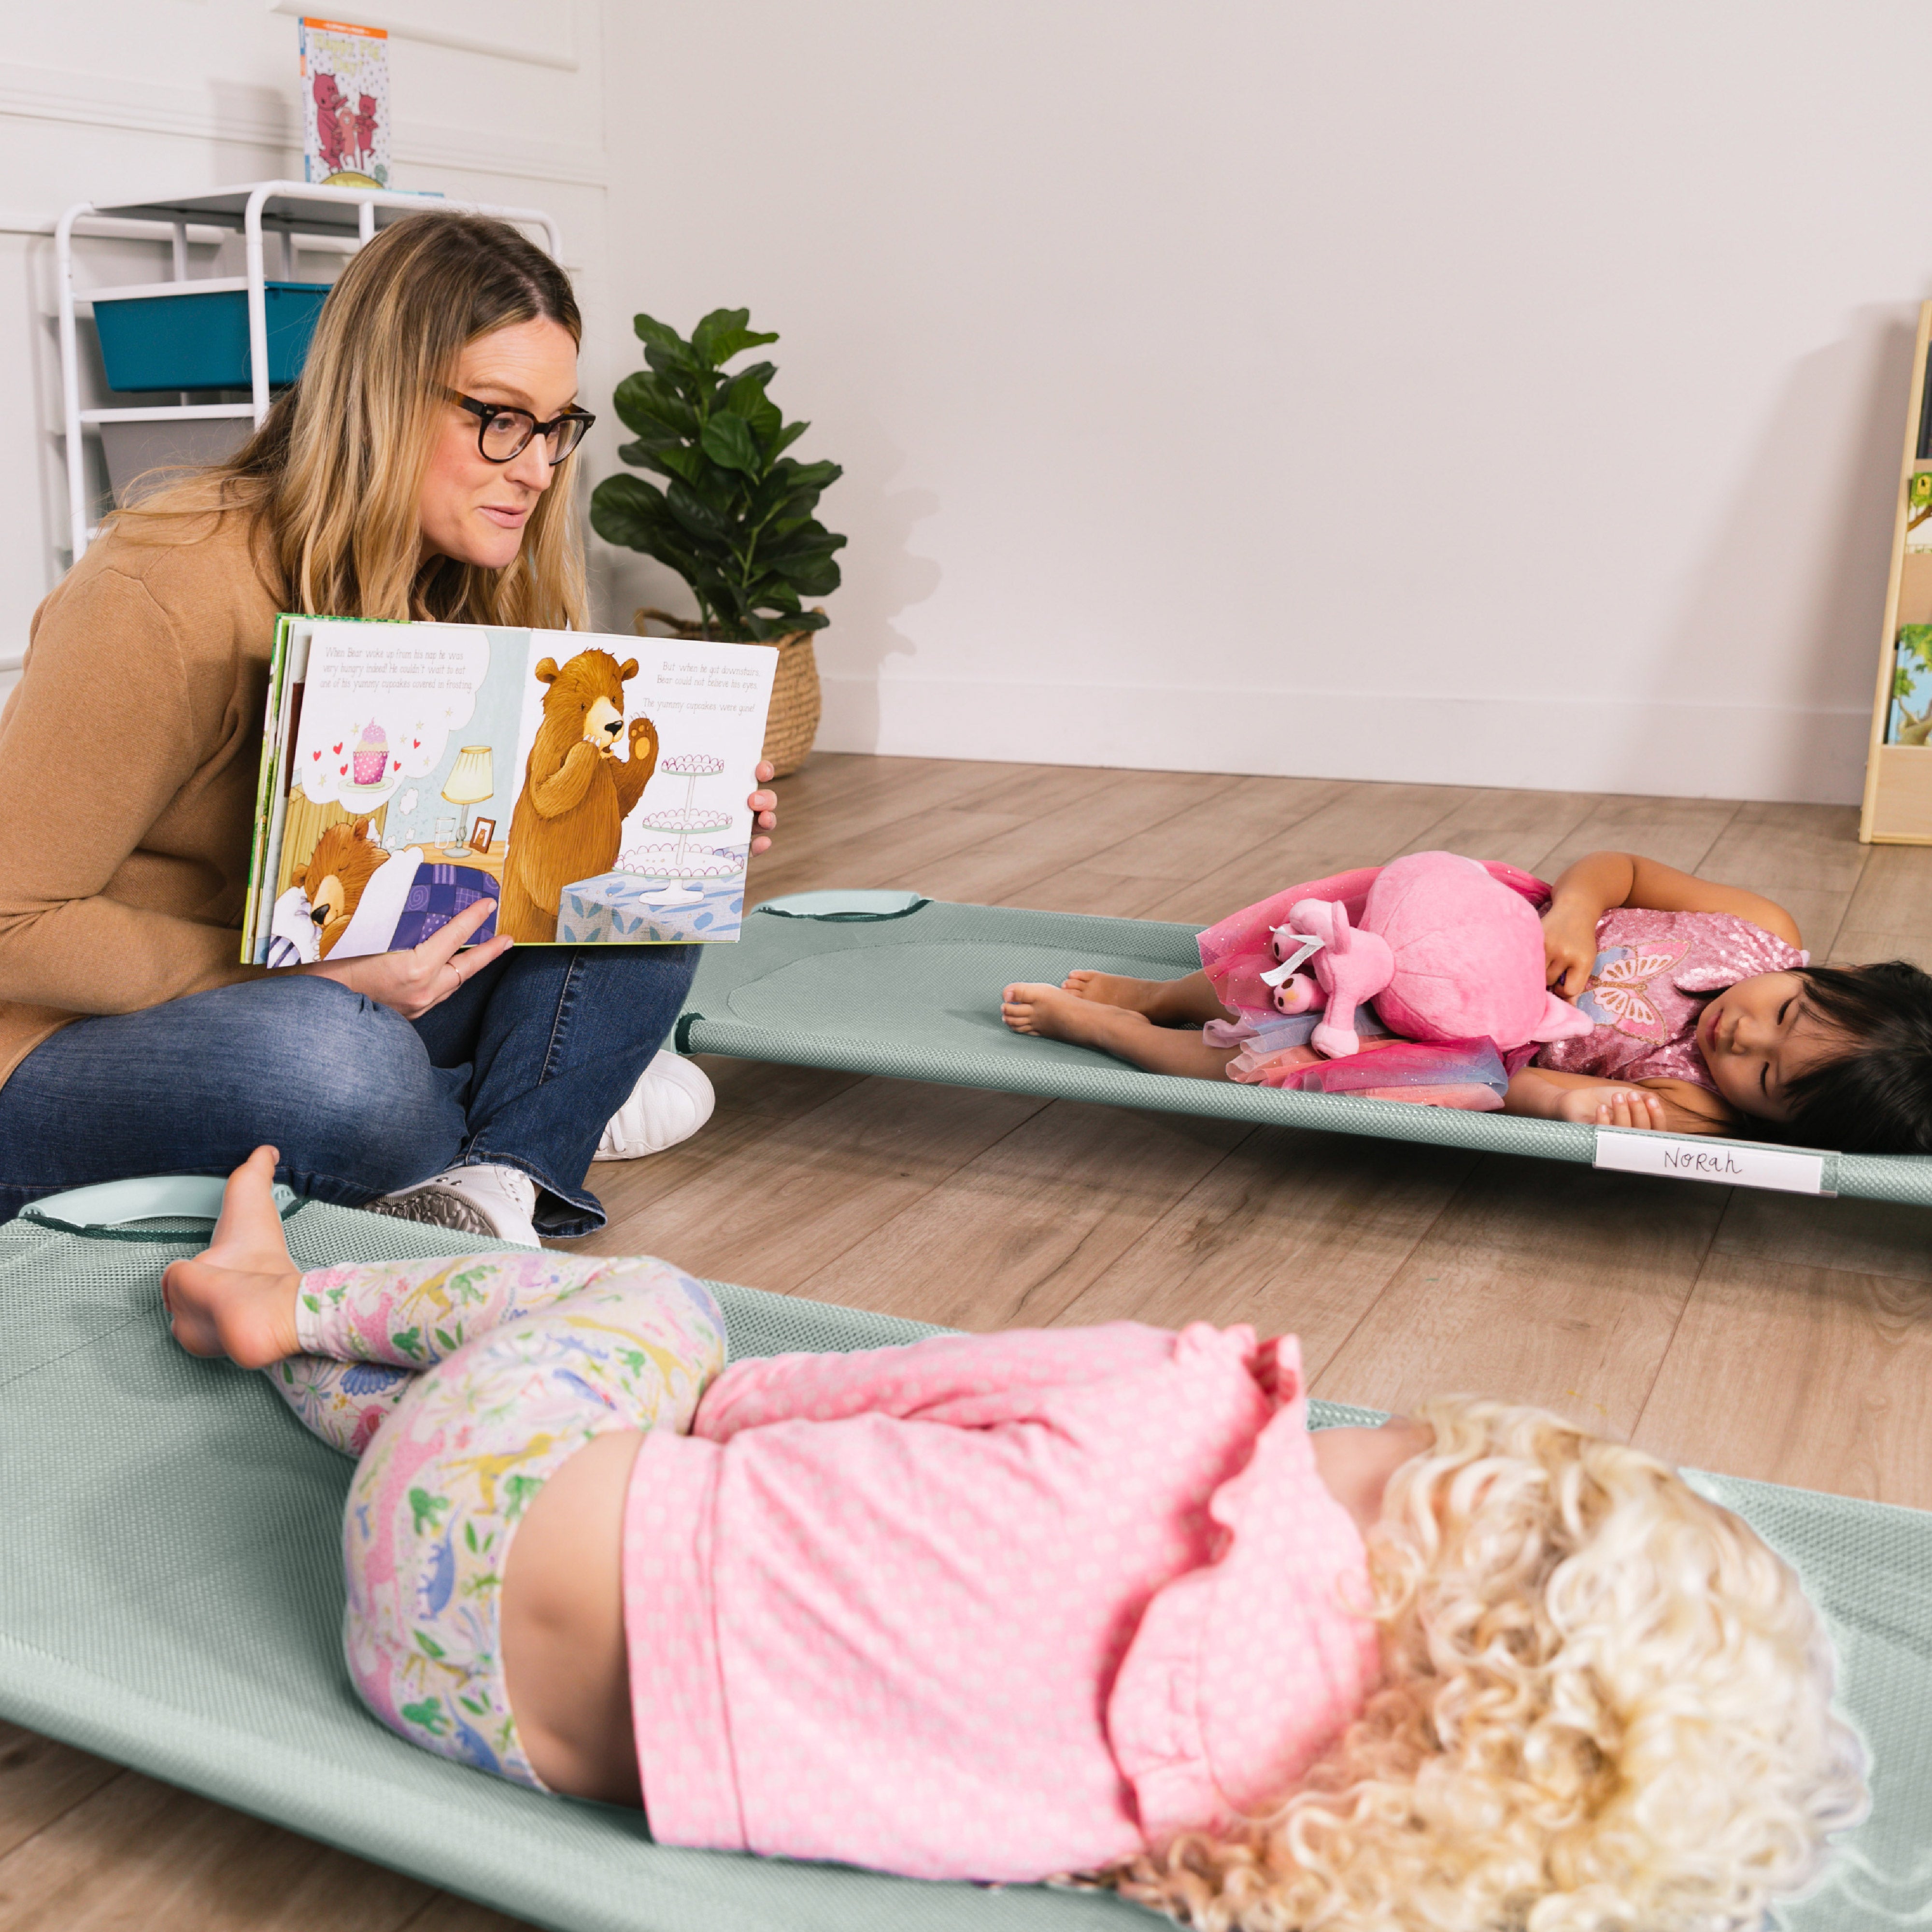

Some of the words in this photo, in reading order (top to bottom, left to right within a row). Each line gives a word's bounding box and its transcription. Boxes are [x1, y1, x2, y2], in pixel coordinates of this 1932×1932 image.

[326, 647, 344, 657] When
[347, 648, 362, 657] Bear
[366, 648, 383, 658] woke
[386, 651, 394, 663] up
[397, 649, 412, 659] from
[414, 650, 423, 659] his
[426, 653, 436, 664] nap
[439, 650, 445, 659] he
[323, 666, 338, 676] very
[341, 664, 364, 677] hungry
[390, 664, 397, 673] He
[428, 665, 444, 674] wait
[447, 666, 453, 674] to
[455, 666, 466, 675] eat
[663, 662, 675, 670] But
[679, 664, 697, 672] when
[700, 664, 707, 673] he
[710, 666, 719, 678] got
[334, 679, 341, 688] of
[353, 680, 379, 692] yummy
[382, 679, 410, 693] cupcakes
[413, 679, 435, 688] covered
[657, 675, 672, 683] Bear
[675, 677, 692, 685] could
[708, 679, 728, 687] believe
[731, 680, 740, 688] his
[643, 697, 654, 707] The
[657, 700, 684, 711] yummy
[687, 701, 716, 714] cupcakes
